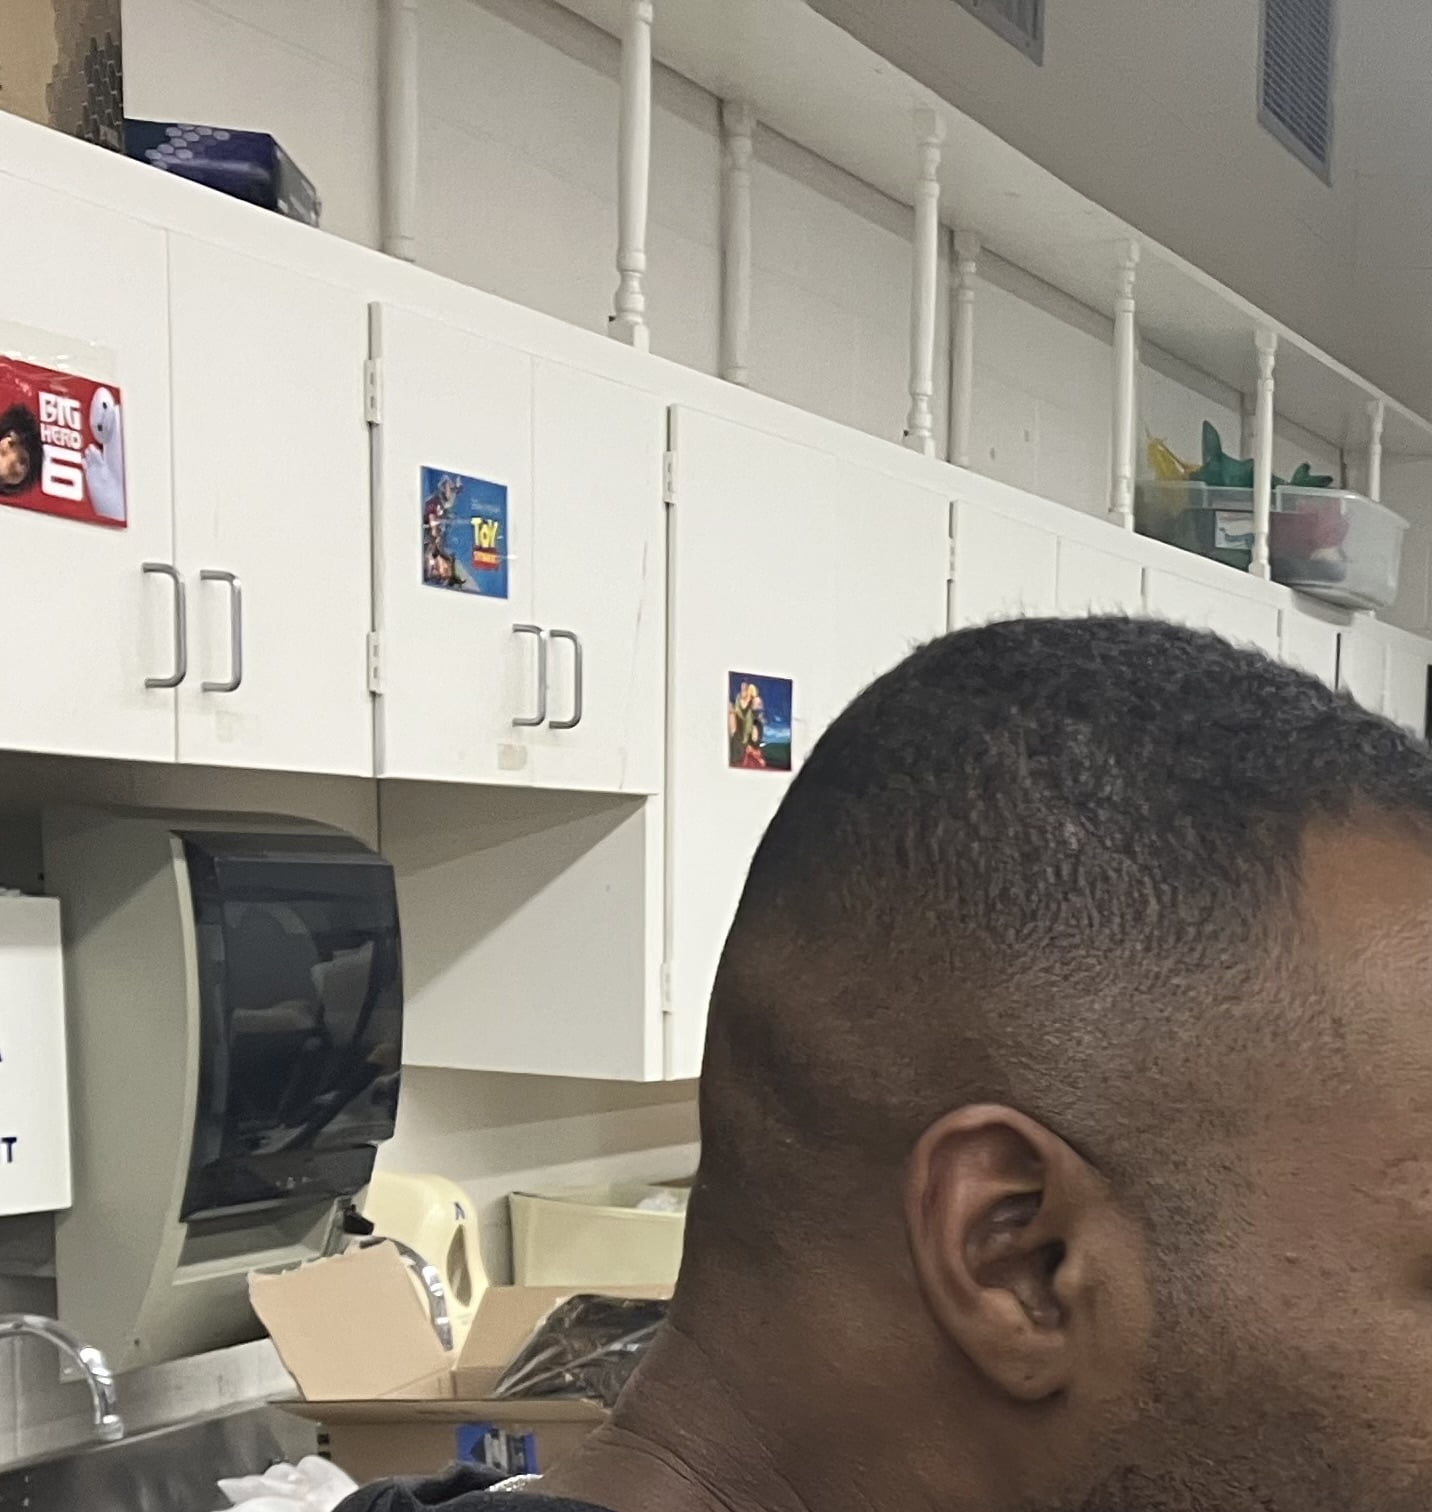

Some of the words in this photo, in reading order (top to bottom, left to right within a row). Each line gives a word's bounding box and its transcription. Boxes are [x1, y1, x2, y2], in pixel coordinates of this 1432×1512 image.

[39, 391, 82, 431] BIG
[41, 423, 82, 450] HERO
[42, 445, 83, 502] 6
[470, 517, 498, 548] TOY
